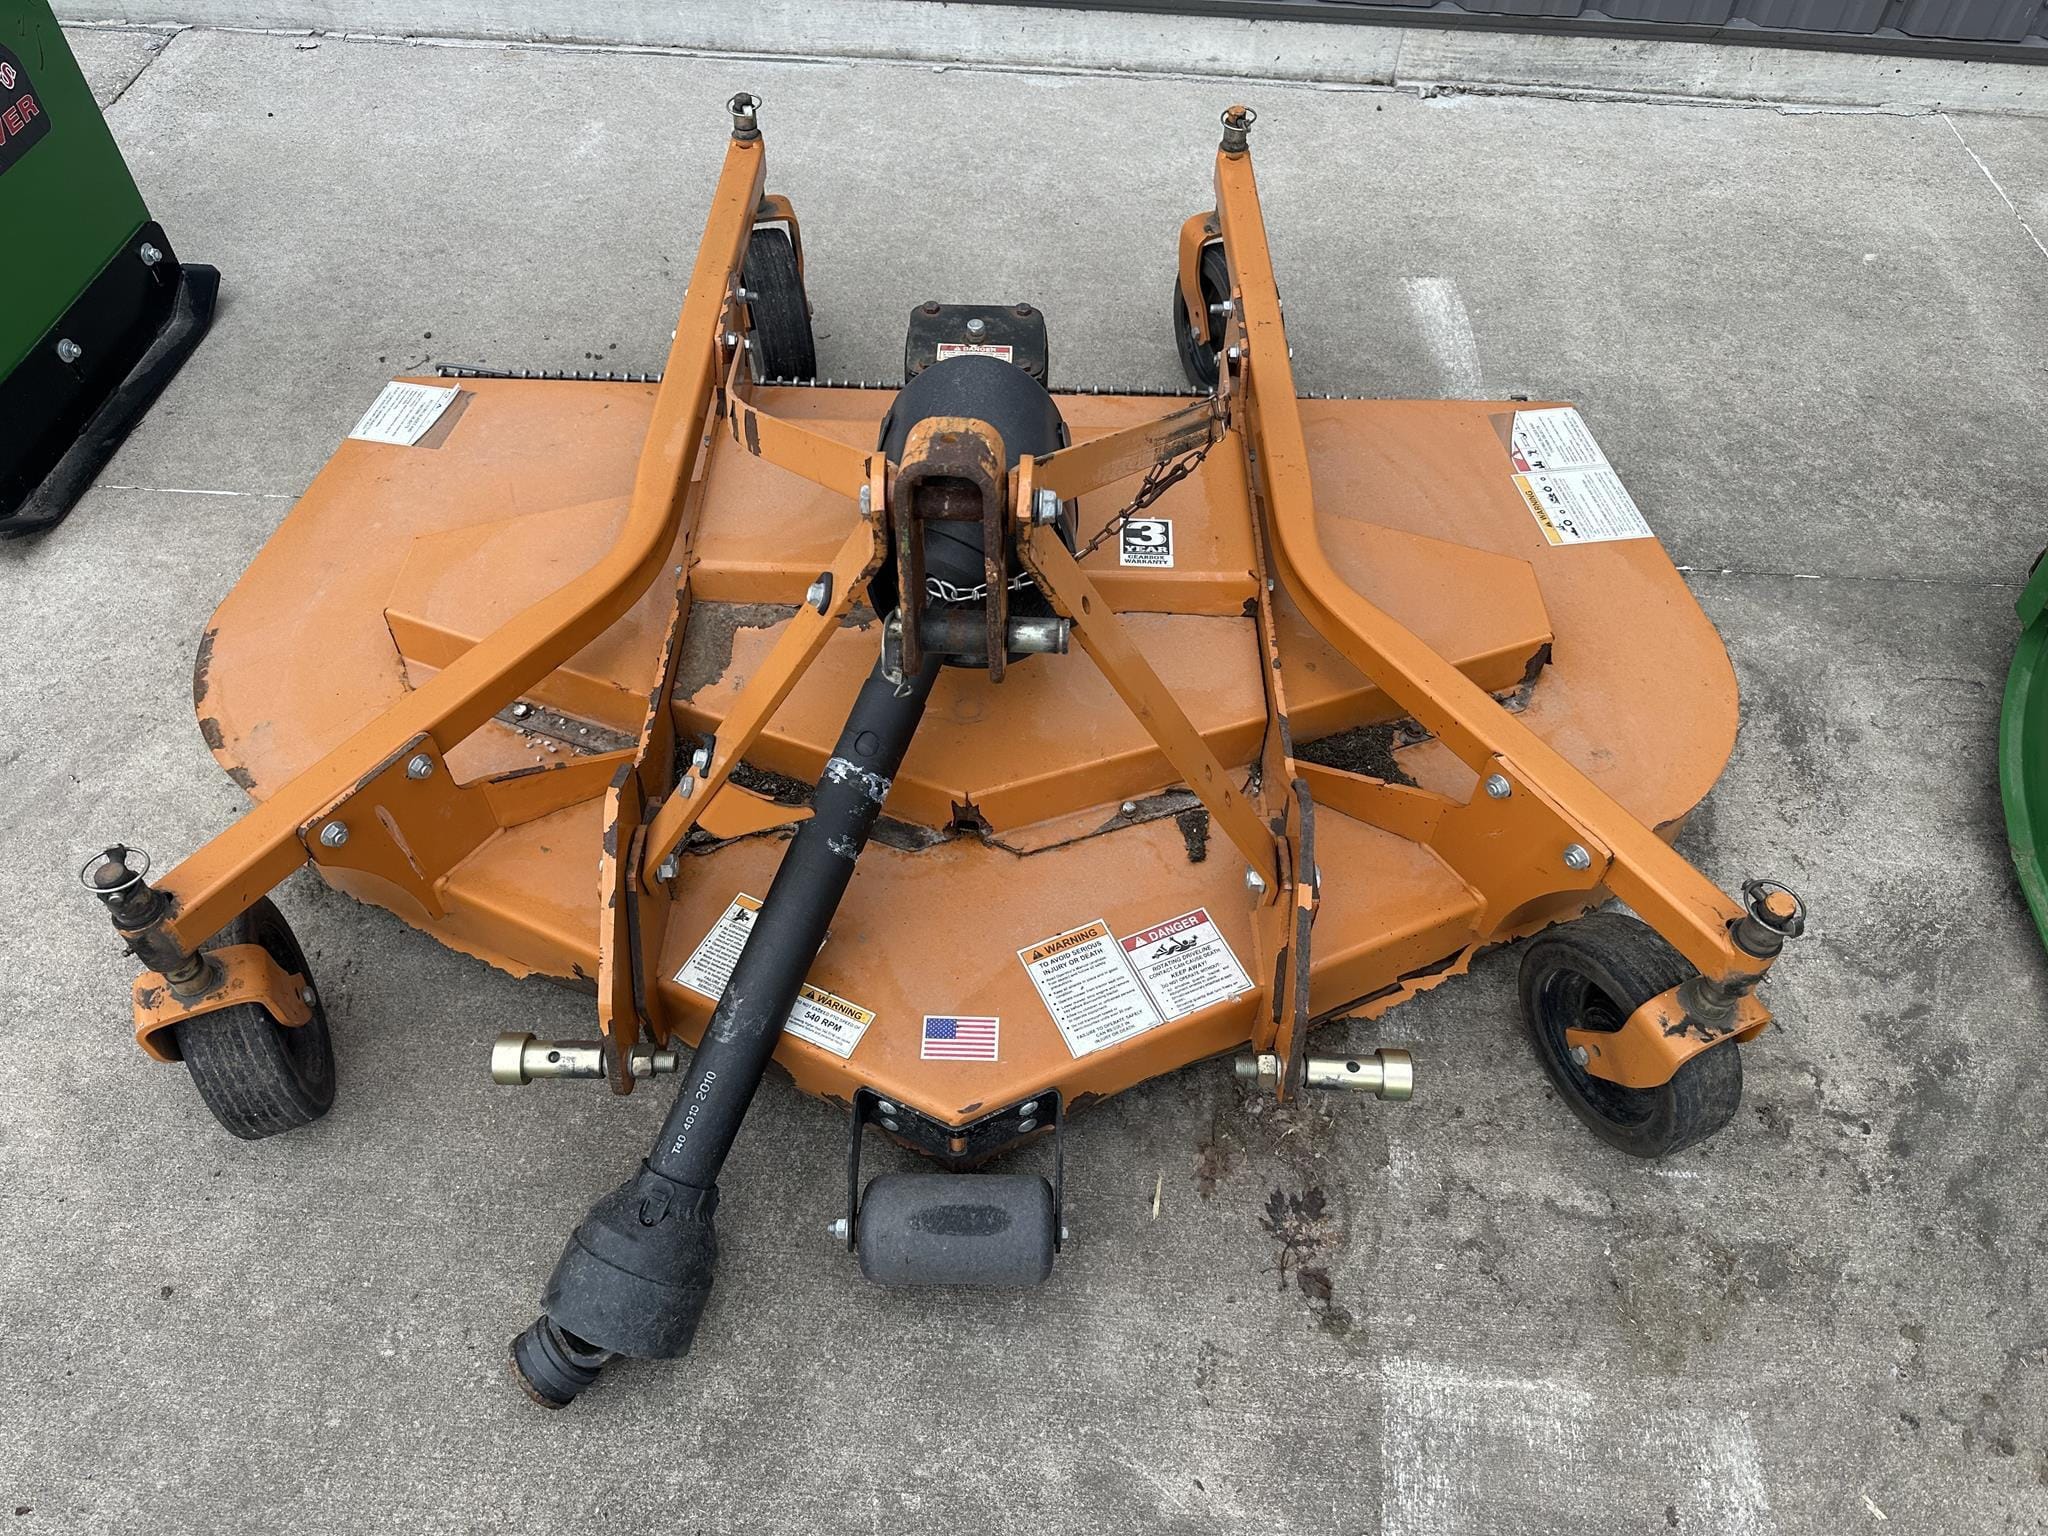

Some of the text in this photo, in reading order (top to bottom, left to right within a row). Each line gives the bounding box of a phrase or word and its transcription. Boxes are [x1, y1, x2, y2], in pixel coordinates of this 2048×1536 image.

[1525, 490, 1549, 524] WARNING
[1126, 522, 1166, 546] 3
[1044, 927, 1098, 954] WARNING
[1147, 915, 1199, 941] DANGER
[1042, 961, 1067, 975] INJURY
[1067, 957, 1079, 965] OR
[1079, 947, 1103, 960] DEATH
[1048, 952, 1071, 964] AVOID
[1071, 940, 1102, 956] SERIOUS
[1148, 947, 1221, 979] CONTACT CAN CAUSE DEATH
[1151, 944, 1212, 971] ROTATING DRIVELINE
[1170, 960, 1208, 978] KEEP AWAY!
[1178, 970, 1199, 981] OPERATE
[816, 994, 863, 1020] WARNING
[1103, 1017, 1125, 1028] OPERATE
[1125, 1009, 1143, 1019] SAFELY
[803, 1010, 821, 1023] 540
[820, 1017, 842, 1032] RPM
[671, 1070, 717, 1154] T40 4010 2010
